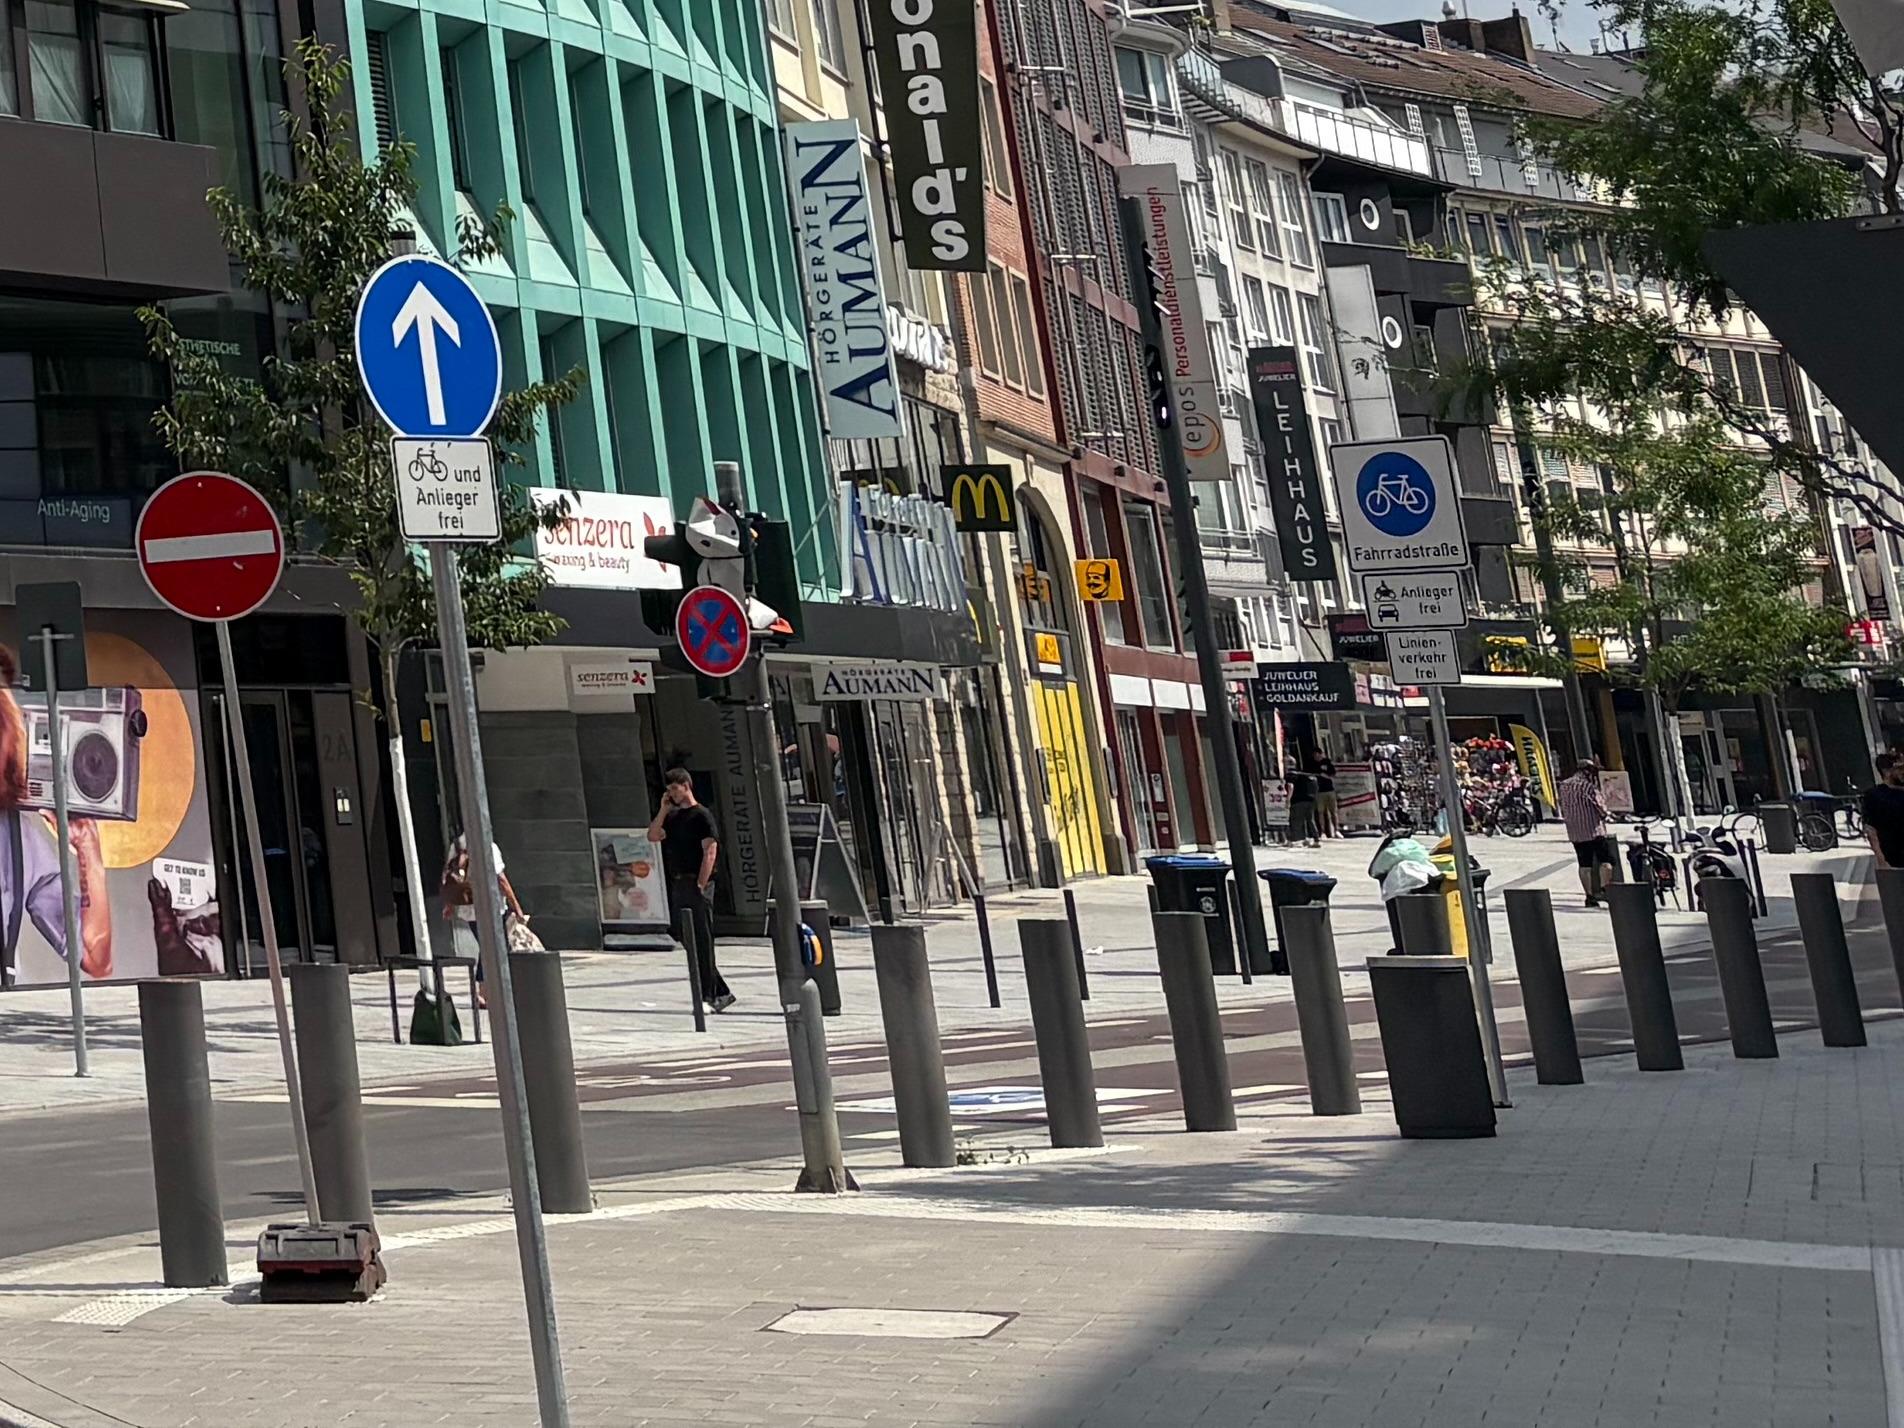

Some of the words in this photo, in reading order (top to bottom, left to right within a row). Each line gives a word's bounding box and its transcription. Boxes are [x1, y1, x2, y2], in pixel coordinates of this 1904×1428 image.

[794, 135, 898, 425] AUMANN
[804, 204, 842, 365] HÖRGERÄTE
[1147, 186, 1192, 379] Personaldienstleistungen
[1180, 385, 1205, 443] epos
[454, 466, 482, 483] und
[1273, 391, 1319, 568] LEIHHAUS
[416, 486, 480, 510] Anlieger
[37, 499, 111, 524] Anti-Aging
[438, 511, 464, 530] frei
[1354, 542, 1460, 562] Fahrradstraße
[1400, 586, 1455, 600] Anlieger
[1419, 601, 1442, 615] frei
[1399, 635, 1442, 649] Linien-
[1398, 651, 1447, 665] verkehr
[576, 671, 630, 682] senzera
[822, 667, 935, 695] AUMANN
[1415, 666, 1438, 680] frei
[720, 706, 744, 777] AUMAN
